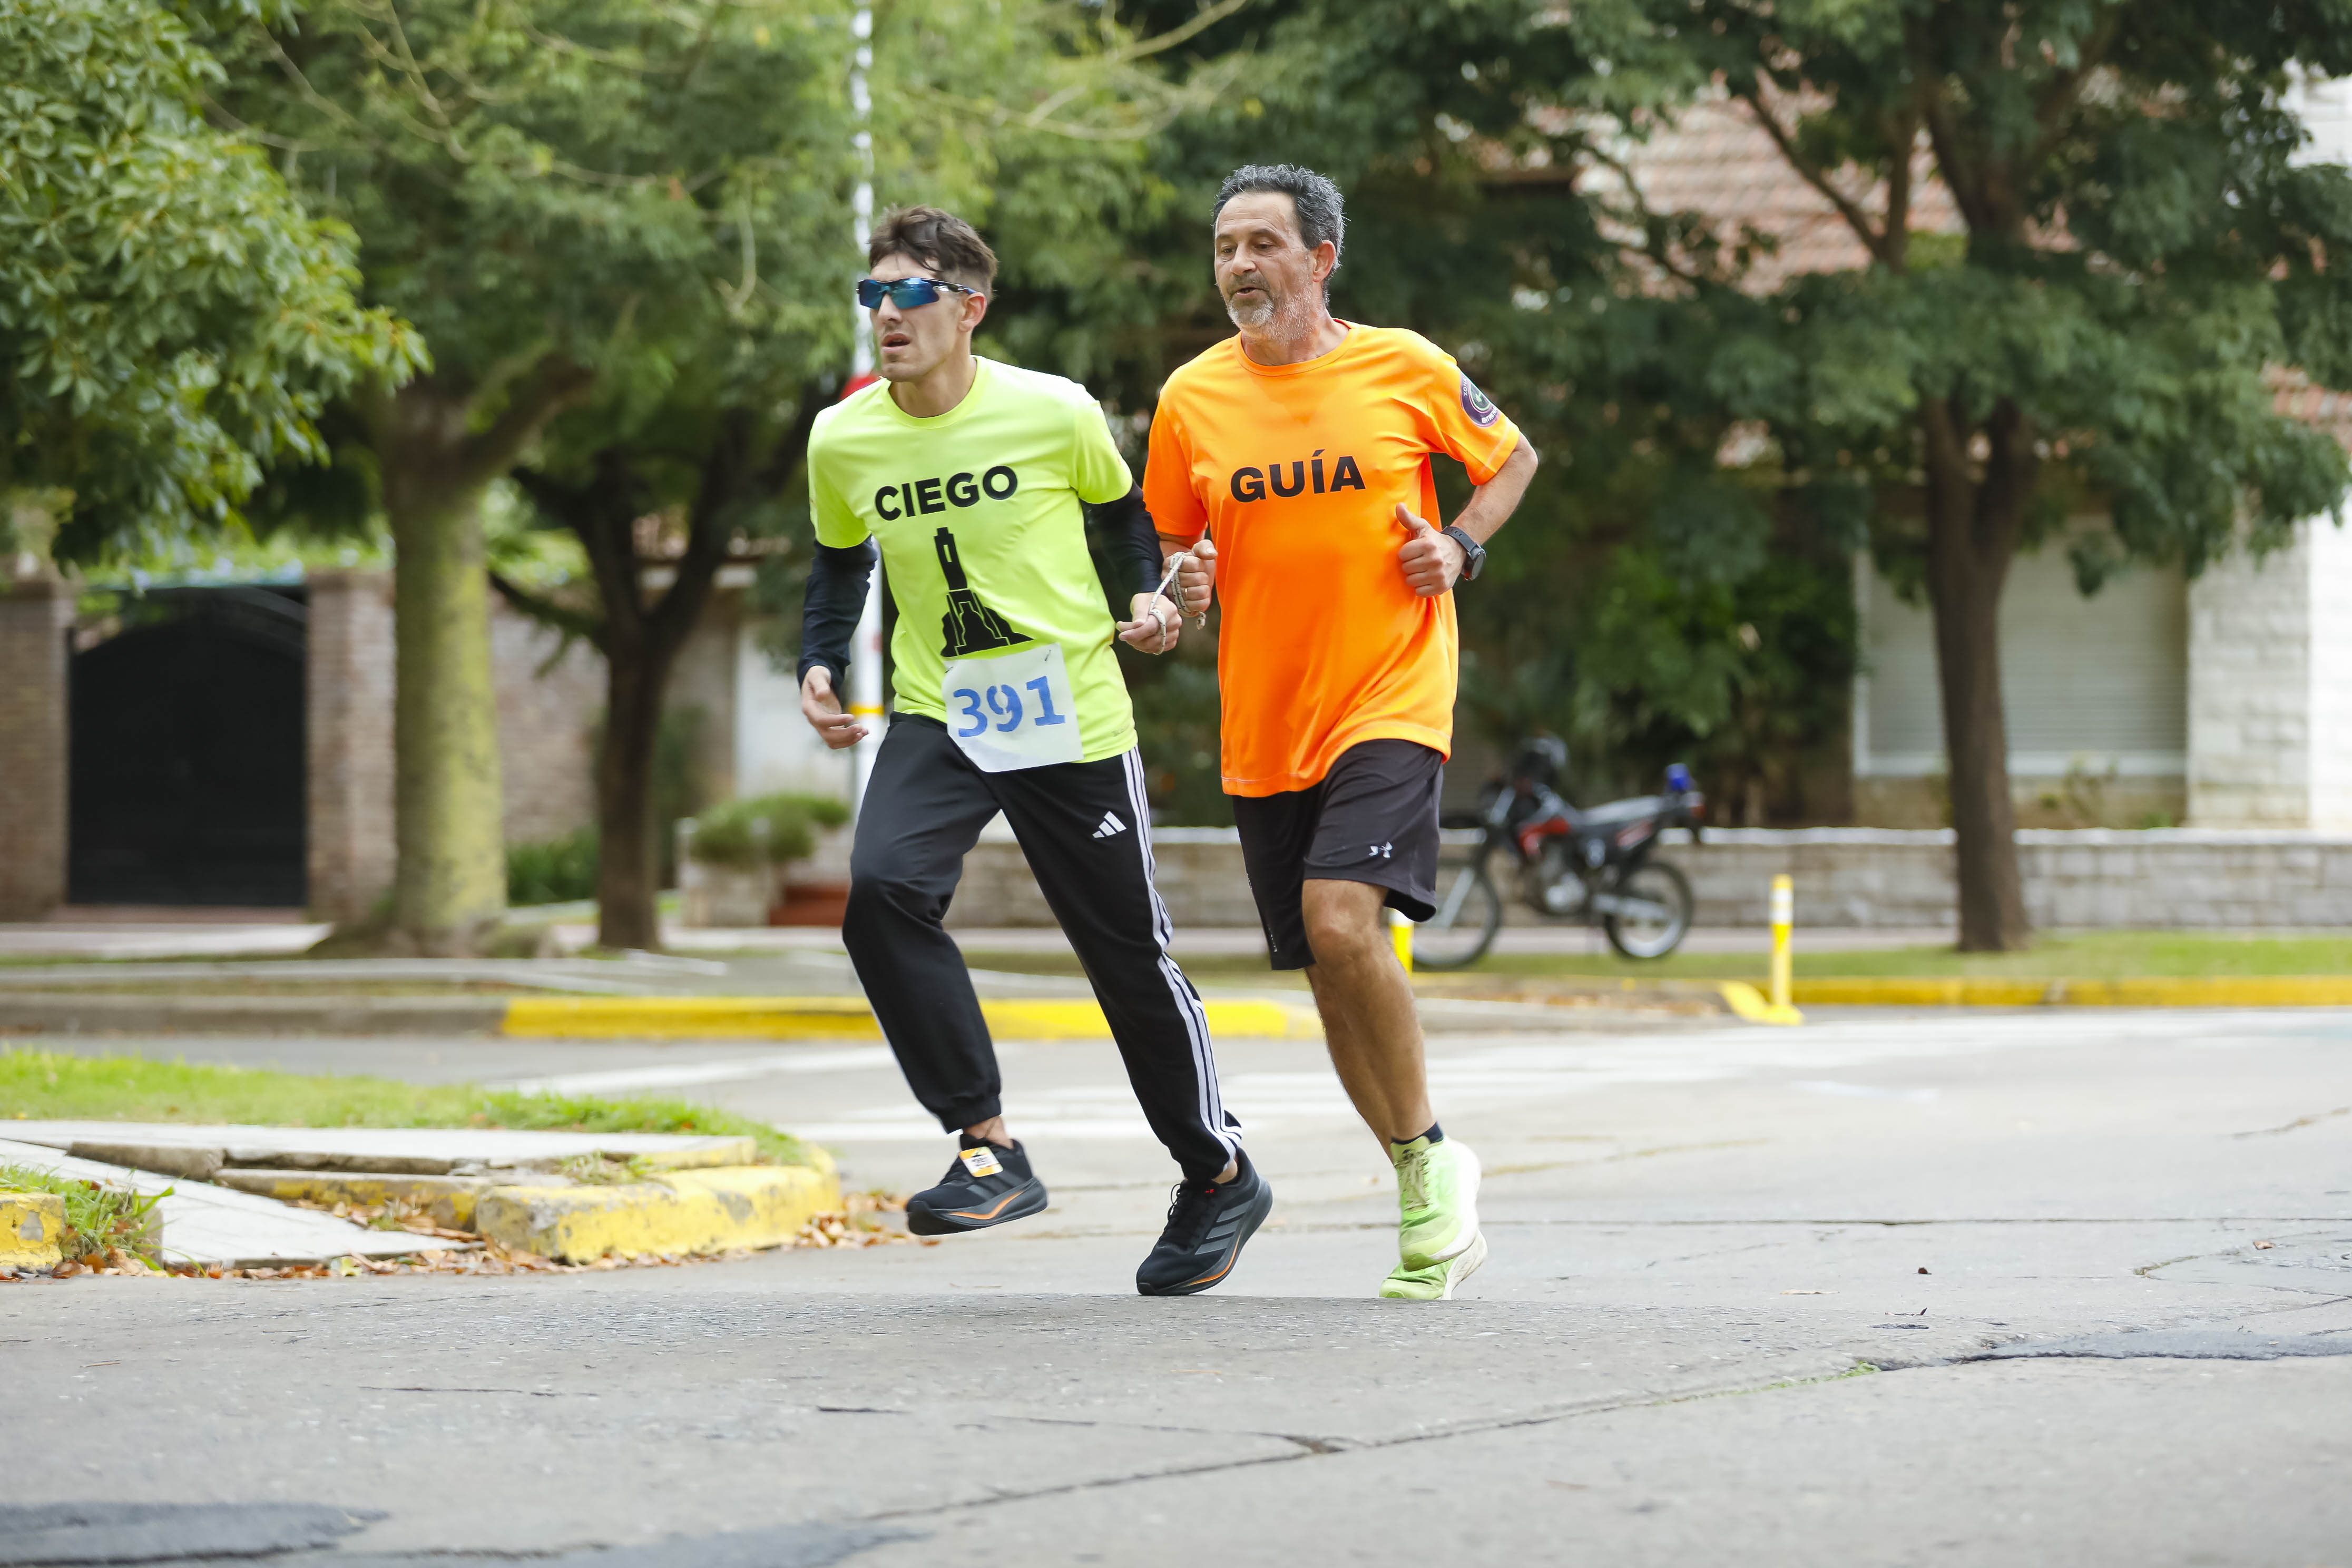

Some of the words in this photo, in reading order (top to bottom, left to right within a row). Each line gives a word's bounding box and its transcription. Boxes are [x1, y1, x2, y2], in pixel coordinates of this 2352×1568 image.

[875, 465, 1018, 521] CIEGO
[1230, 449, 1366, 503] GUÍA
[953, 675, 1065, 738] 391
